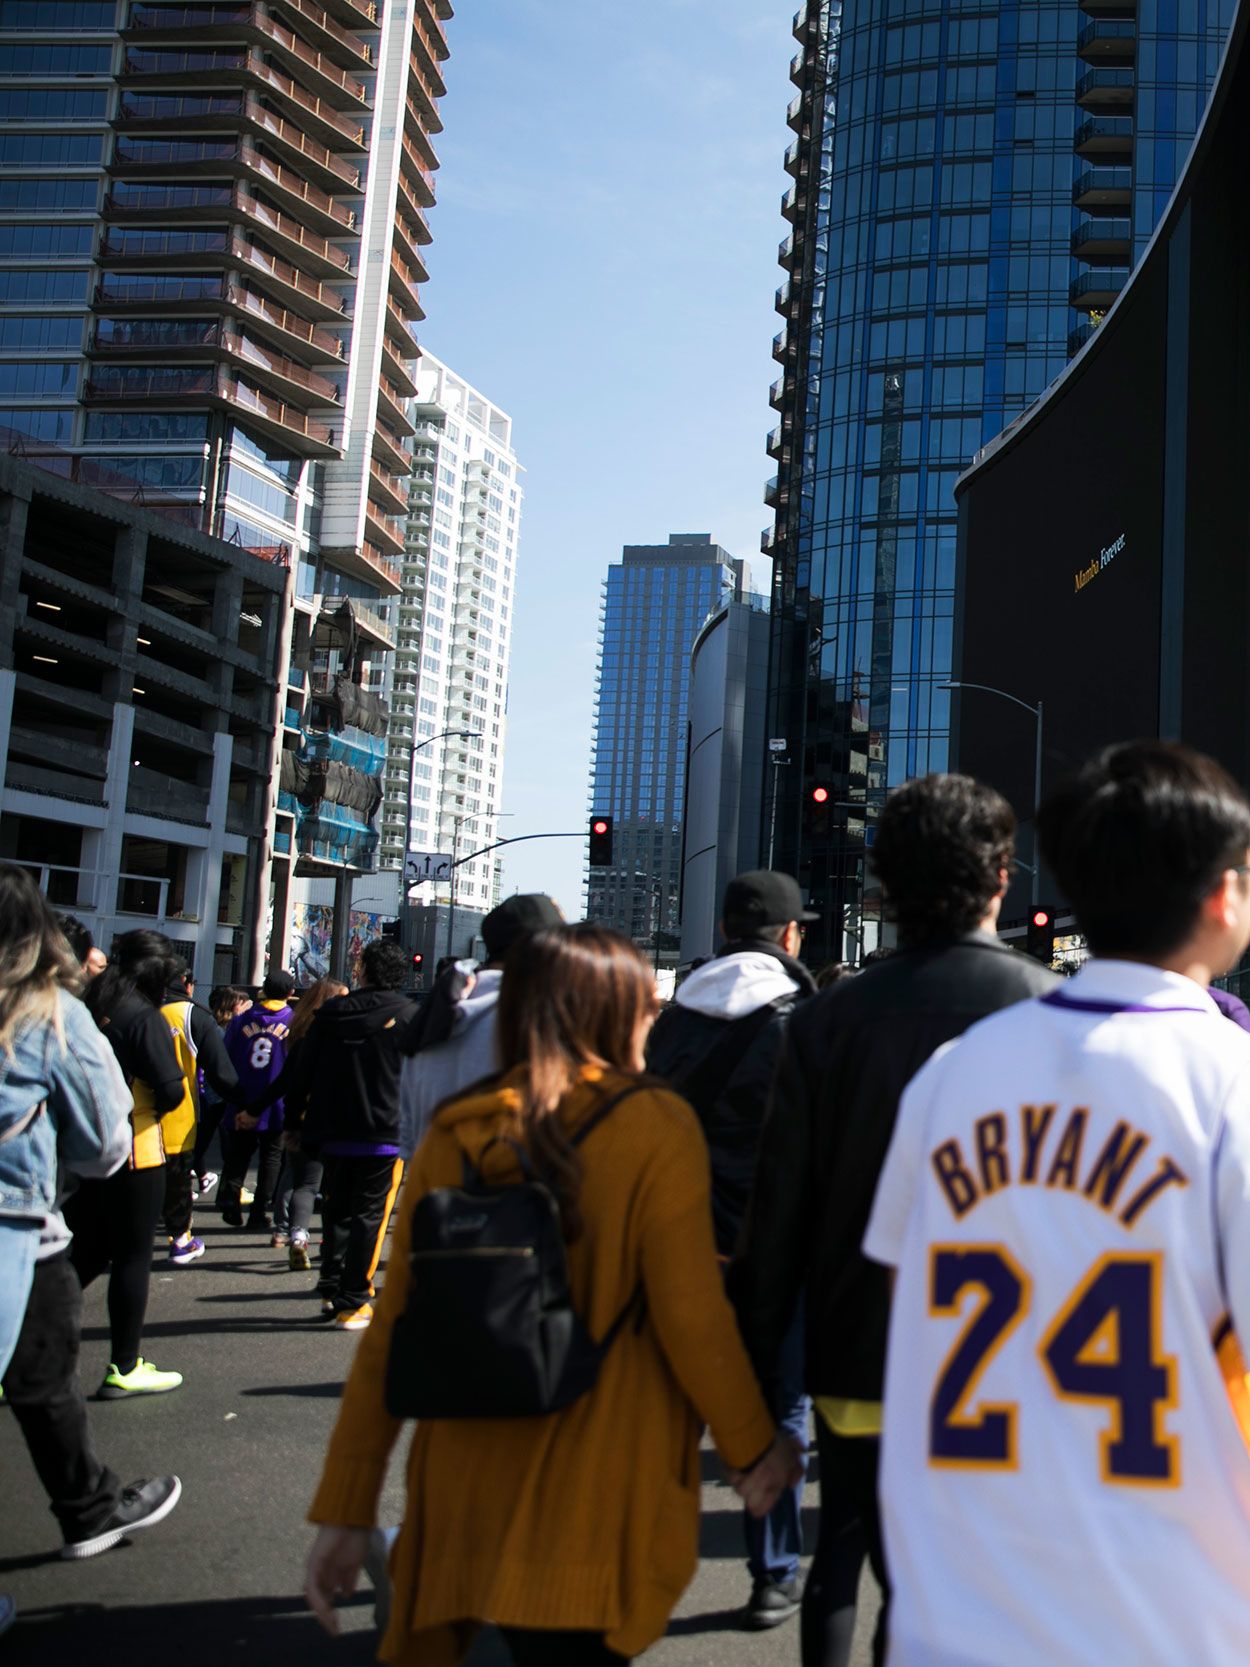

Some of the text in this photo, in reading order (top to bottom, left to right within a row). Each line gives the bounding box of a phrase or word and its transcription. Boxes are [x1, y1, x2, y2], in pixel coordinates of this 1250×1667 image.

[1074, 559, 1099, 593] Mamba
[250, 1037, 273, 1069] 8
[931, 1103, 1190, 1232] BRYANT
[928, 1241, 1182, 1489] 24
